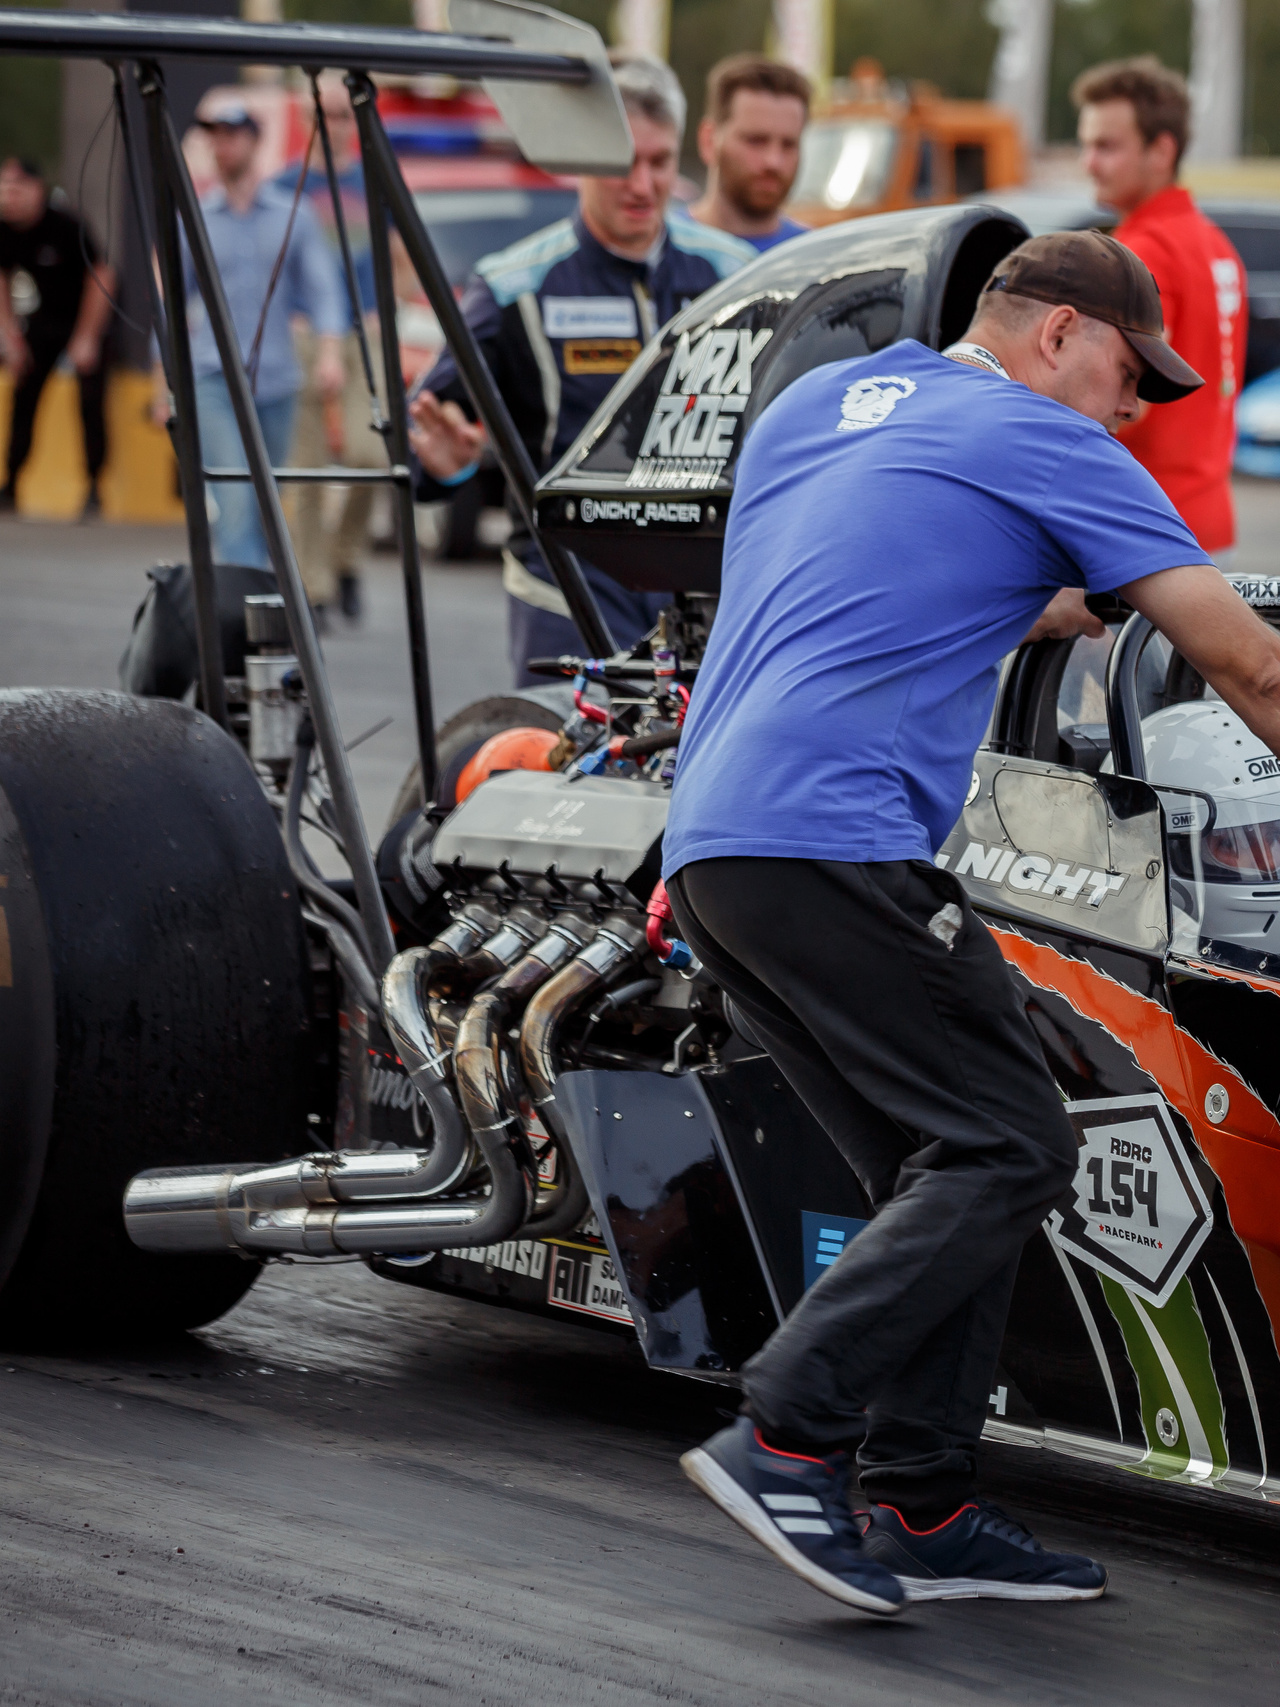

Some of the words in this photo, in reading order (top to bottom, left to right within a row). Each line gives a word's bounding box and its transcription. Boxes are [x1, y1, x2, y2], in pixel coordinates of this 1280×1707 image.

[661, 328, 773, 395] MAX
[625, 457, 728, 490] MOTORSPORT
[1171, 813, 1196, 826] OMP
[954, 840, 1126, 908] NIGHT
[1110, 1136, 1153, 1165] RDRC
[1086, 1156, 1159, 1228] 154
[1104, 1224, 1158, 1249] RACEPARK
